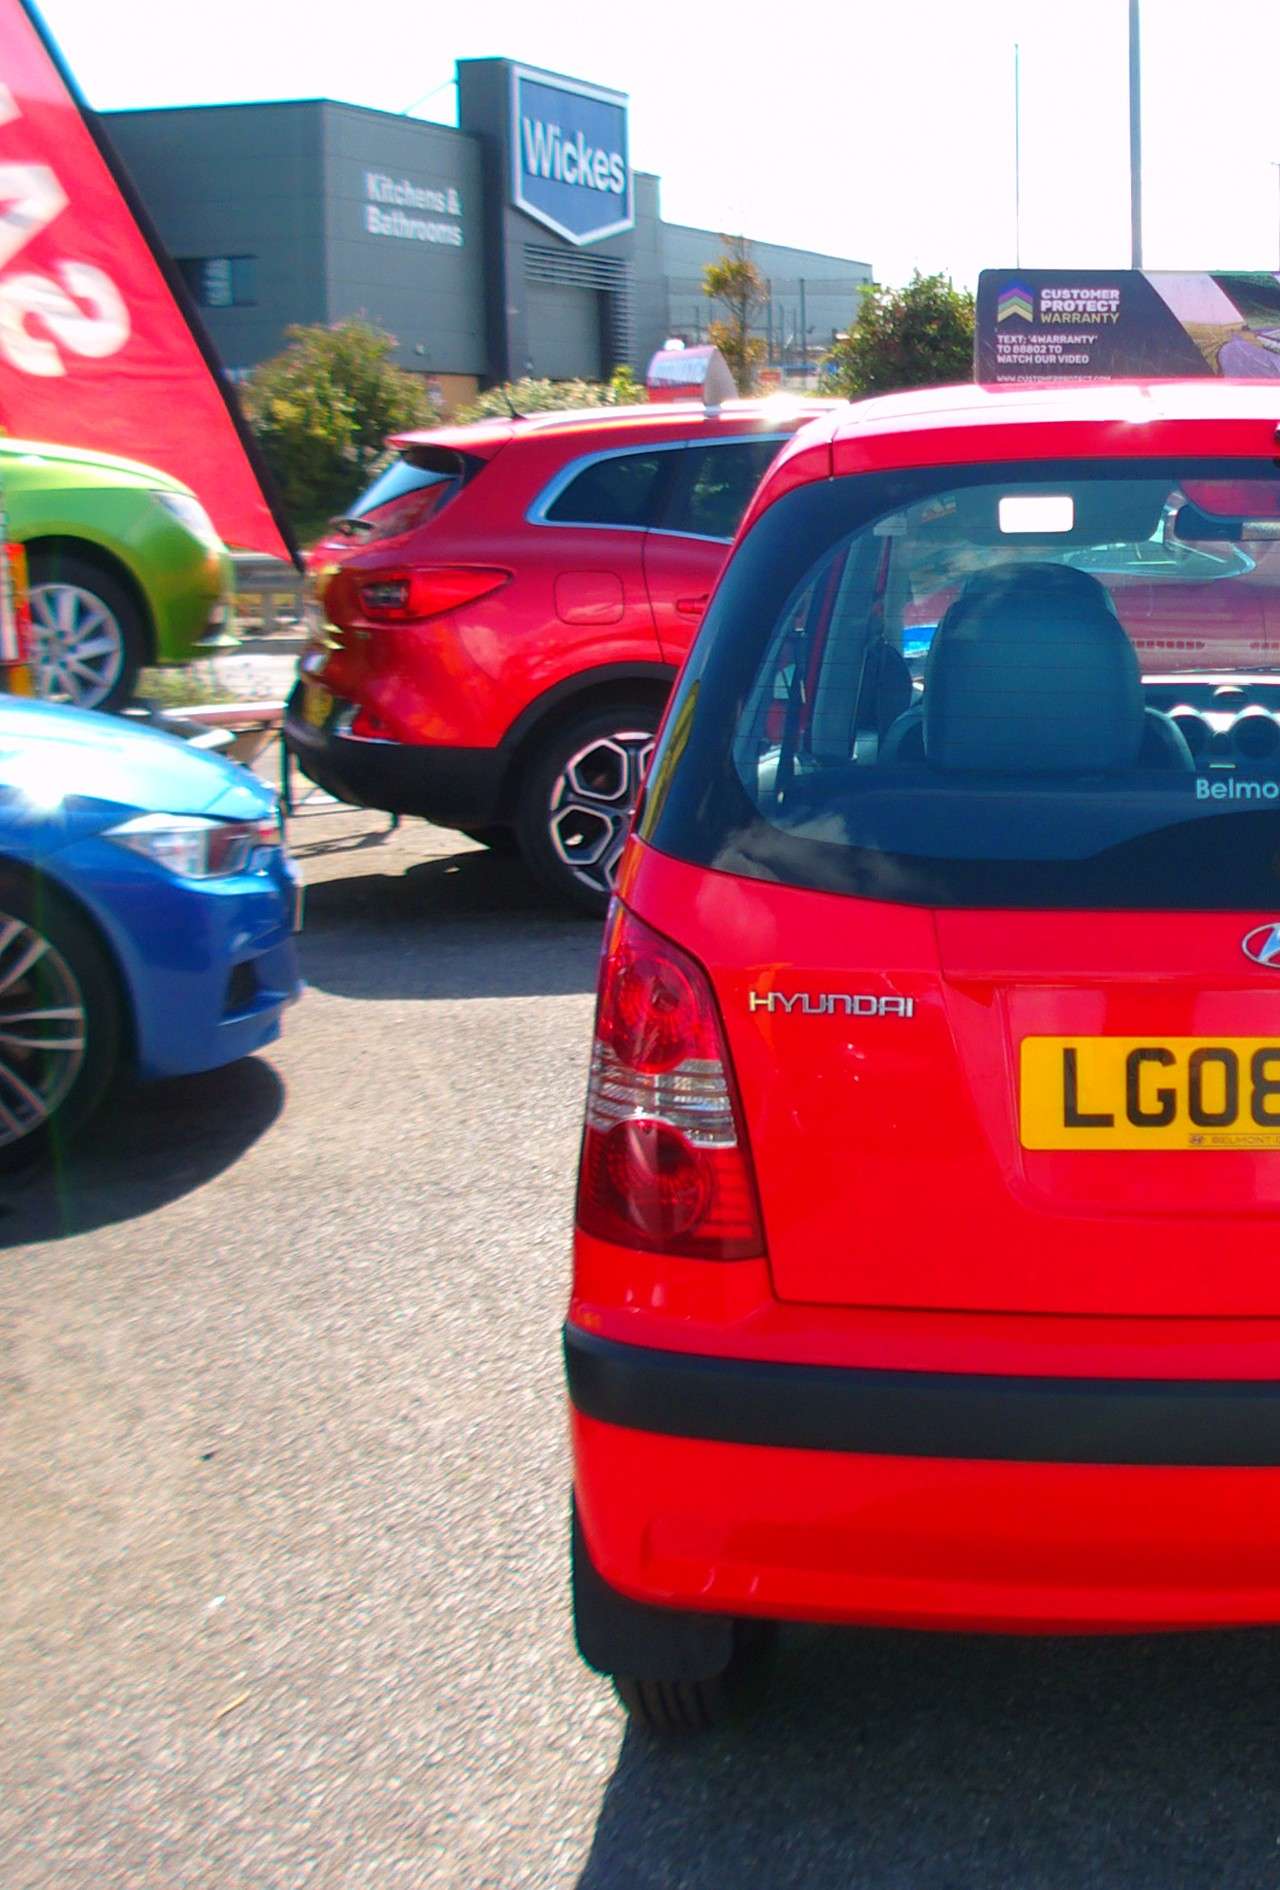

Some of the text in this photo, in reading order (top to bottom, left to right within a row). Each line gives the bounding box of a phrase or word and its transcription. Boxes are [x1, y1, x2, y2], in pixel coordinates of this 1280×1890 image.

[523, 116, 625, 194] Wickes
[367, 172, 462, 216] Kitchens &
[367, 206, 463, 246] Bathrooms
[1040, 288, 1120, 299] CUSTOMER
[1040, 300, 1120, 312] PROTECT
[1040, 312, 1120, 324] WARRANTY
[997, 345, 1011, 353] TO
[1049, 345, 1063, 354] TO
[997, 355, 1089, 364] WATCH OUR VIDEO
[749, 991, 914, 1018] HYUNDAI
